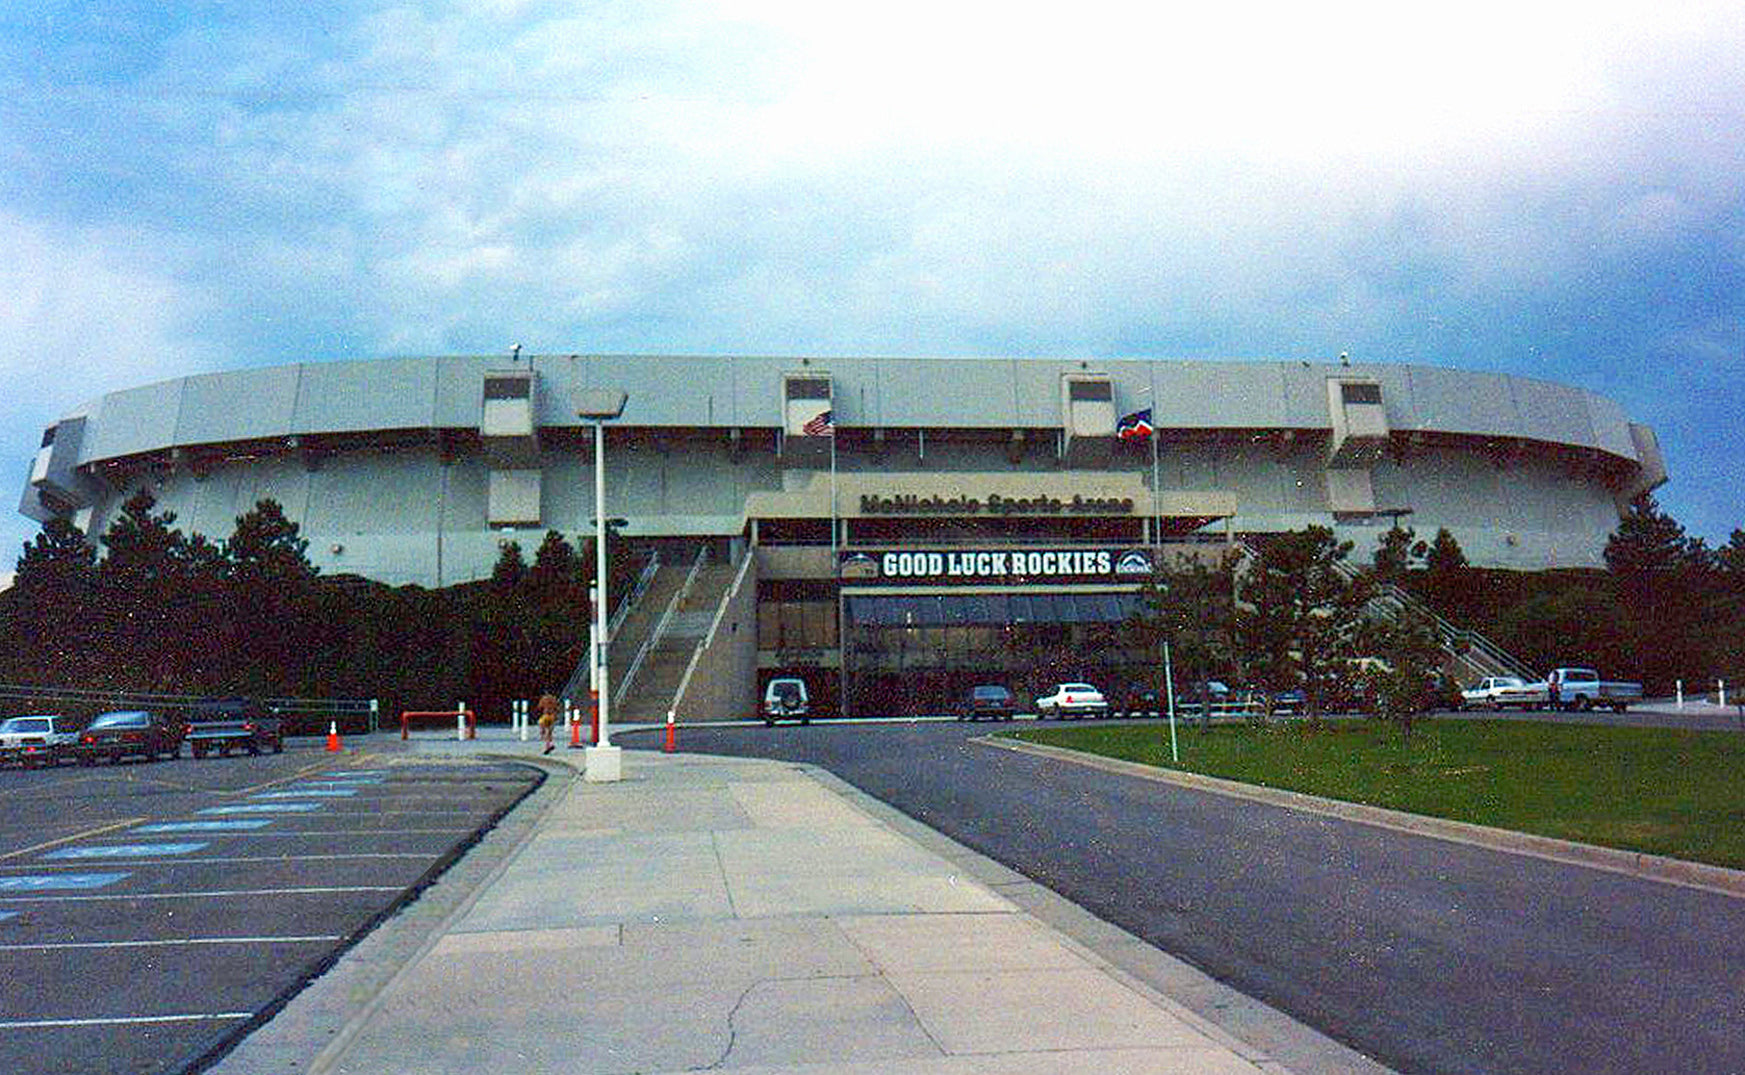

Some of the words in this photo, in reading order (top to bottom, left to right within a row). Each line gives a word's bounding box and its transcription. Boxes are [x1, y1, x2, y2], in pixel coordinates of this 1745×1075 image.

[988, 493, 1061, 514] Sports
[883, 552, 943, 576] GOOD
[947, 552, 1007, 576] LUCK
[1011, 551, 1111, 575] ROCKIES
